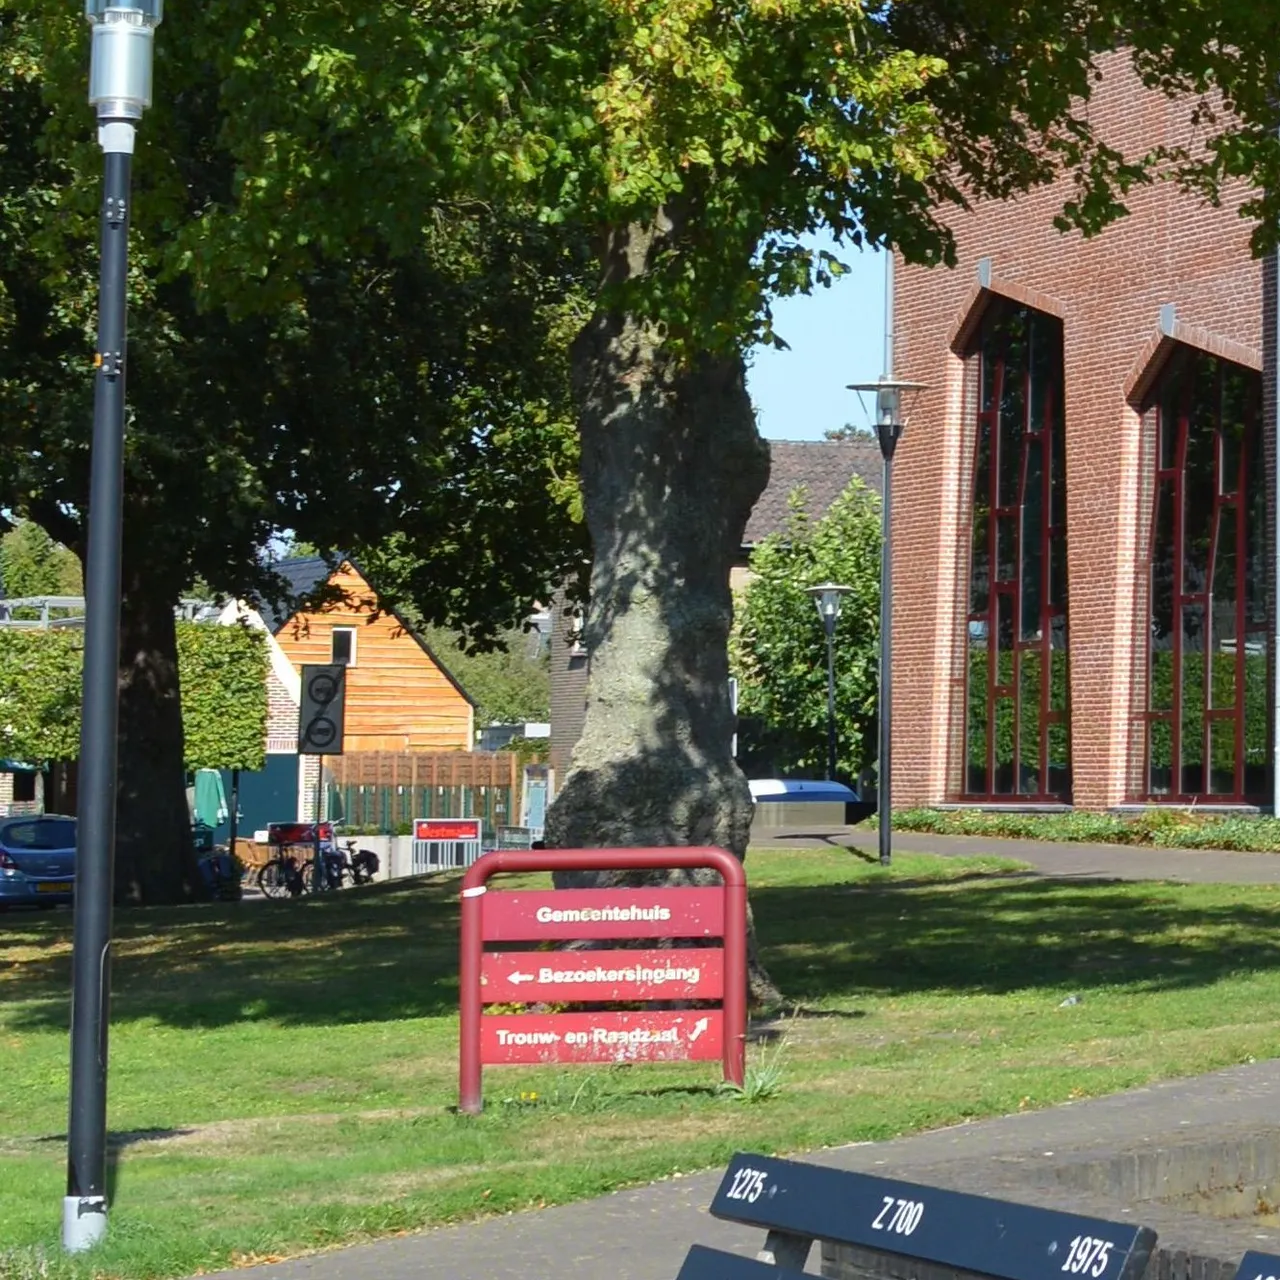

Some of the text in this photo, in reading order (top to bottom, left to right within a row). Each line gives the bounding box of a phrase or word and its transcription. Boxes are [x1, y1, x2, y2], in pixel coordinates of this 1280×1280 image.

[537, 905, 671, 923] Gemeentehuis
[538, 966, 700, 984] Bezoekersingang
[496, 1027, 678, 1045] Trouw- en Raadzaal
[727, 1168, 1113, 1278] 1275 Z 700 1975
